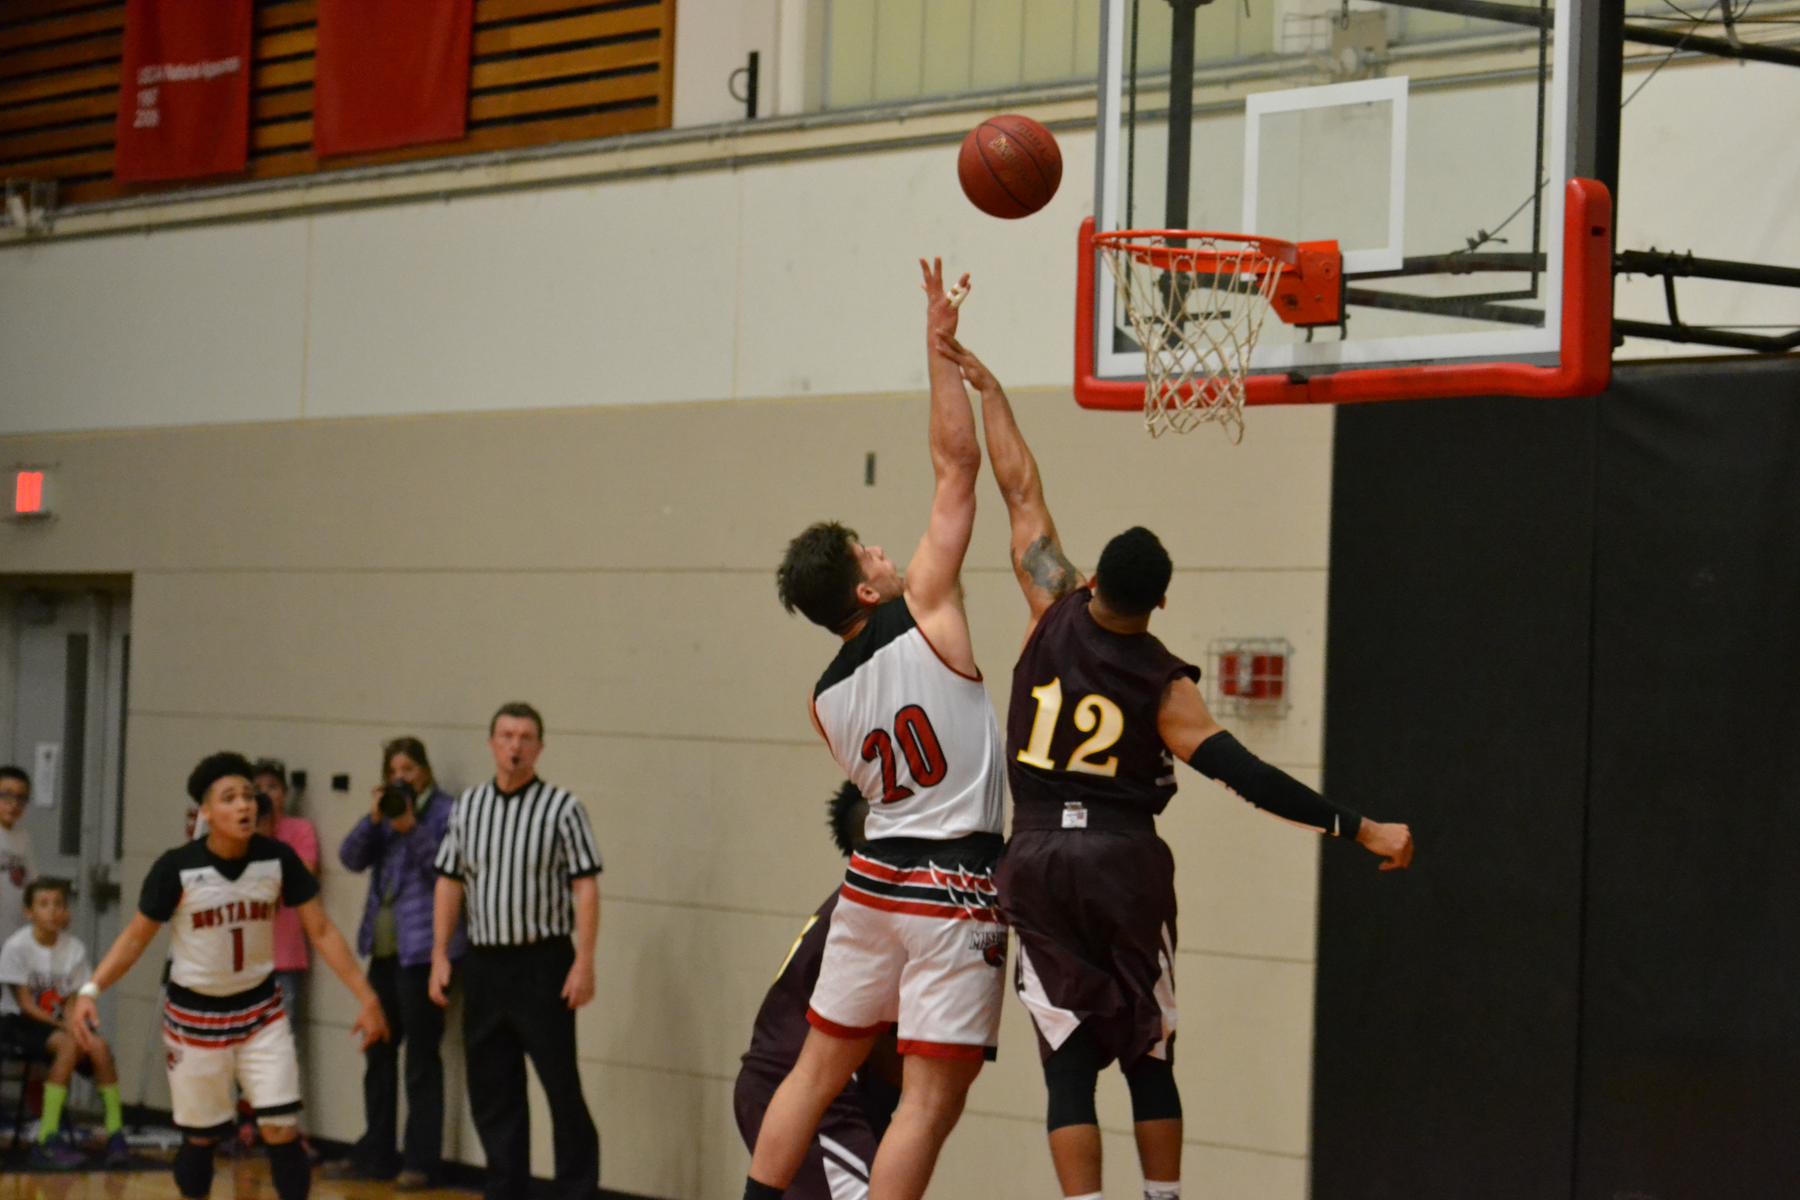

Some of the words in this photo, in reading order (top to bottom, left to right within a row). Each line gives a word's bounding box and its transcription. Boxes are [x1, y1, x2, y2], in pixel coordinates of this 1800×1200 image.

[861, 704, 947, 803] 20
[1017, 677, 1124, 777] 12
[231, 927, 243, 972] 1
